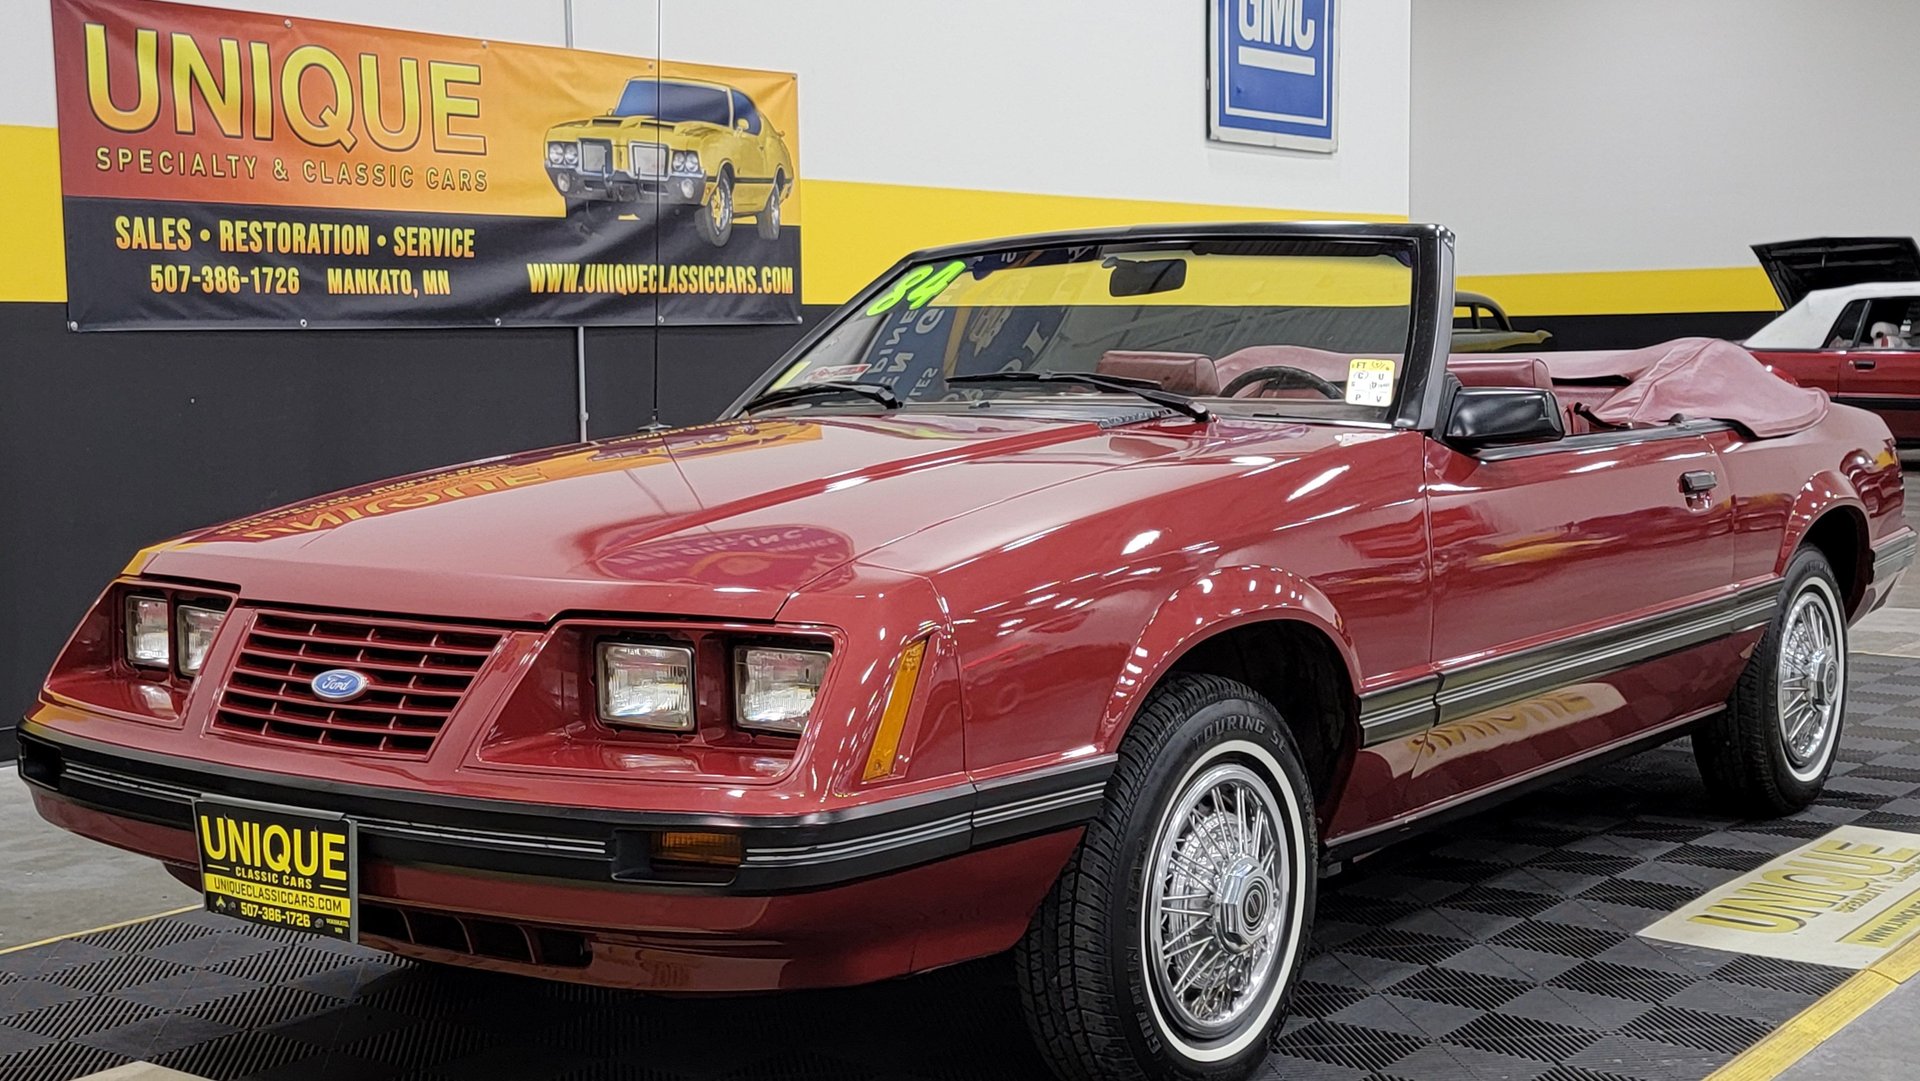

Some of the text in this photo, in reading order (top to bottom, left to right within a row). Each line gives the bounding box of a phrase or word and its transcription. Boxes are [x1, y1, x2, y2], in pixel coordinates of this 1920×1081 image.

[1238, 0, 1315, 51] GMC
[84, 22, 488, 156] UNIQUE
[96, 146, 488, 191] SPECIALTY & CLASSIC CARS
[114, 215, 476, 258] SALES RESTORATION SERVICE
[150, 264, 451, 298] 507-386-1726 MANKATO, MN
[526, 263, 794, 295] WWW.UNIQUECLASSICCARS.COM
[321, 674, 351, 691] Ford
[1192, 714, 1267, 751] TOURING
[201, 815, 347, 881] UNIQUE
[213, 877, 343, 914] UNIQUECLASSICCARS.COM
[235, 866, 313, 890] CLASSIC CARS
[1686, 839, 1920, 934] UNIQUE
[240, 901, 312, 928] 507-386-1726
